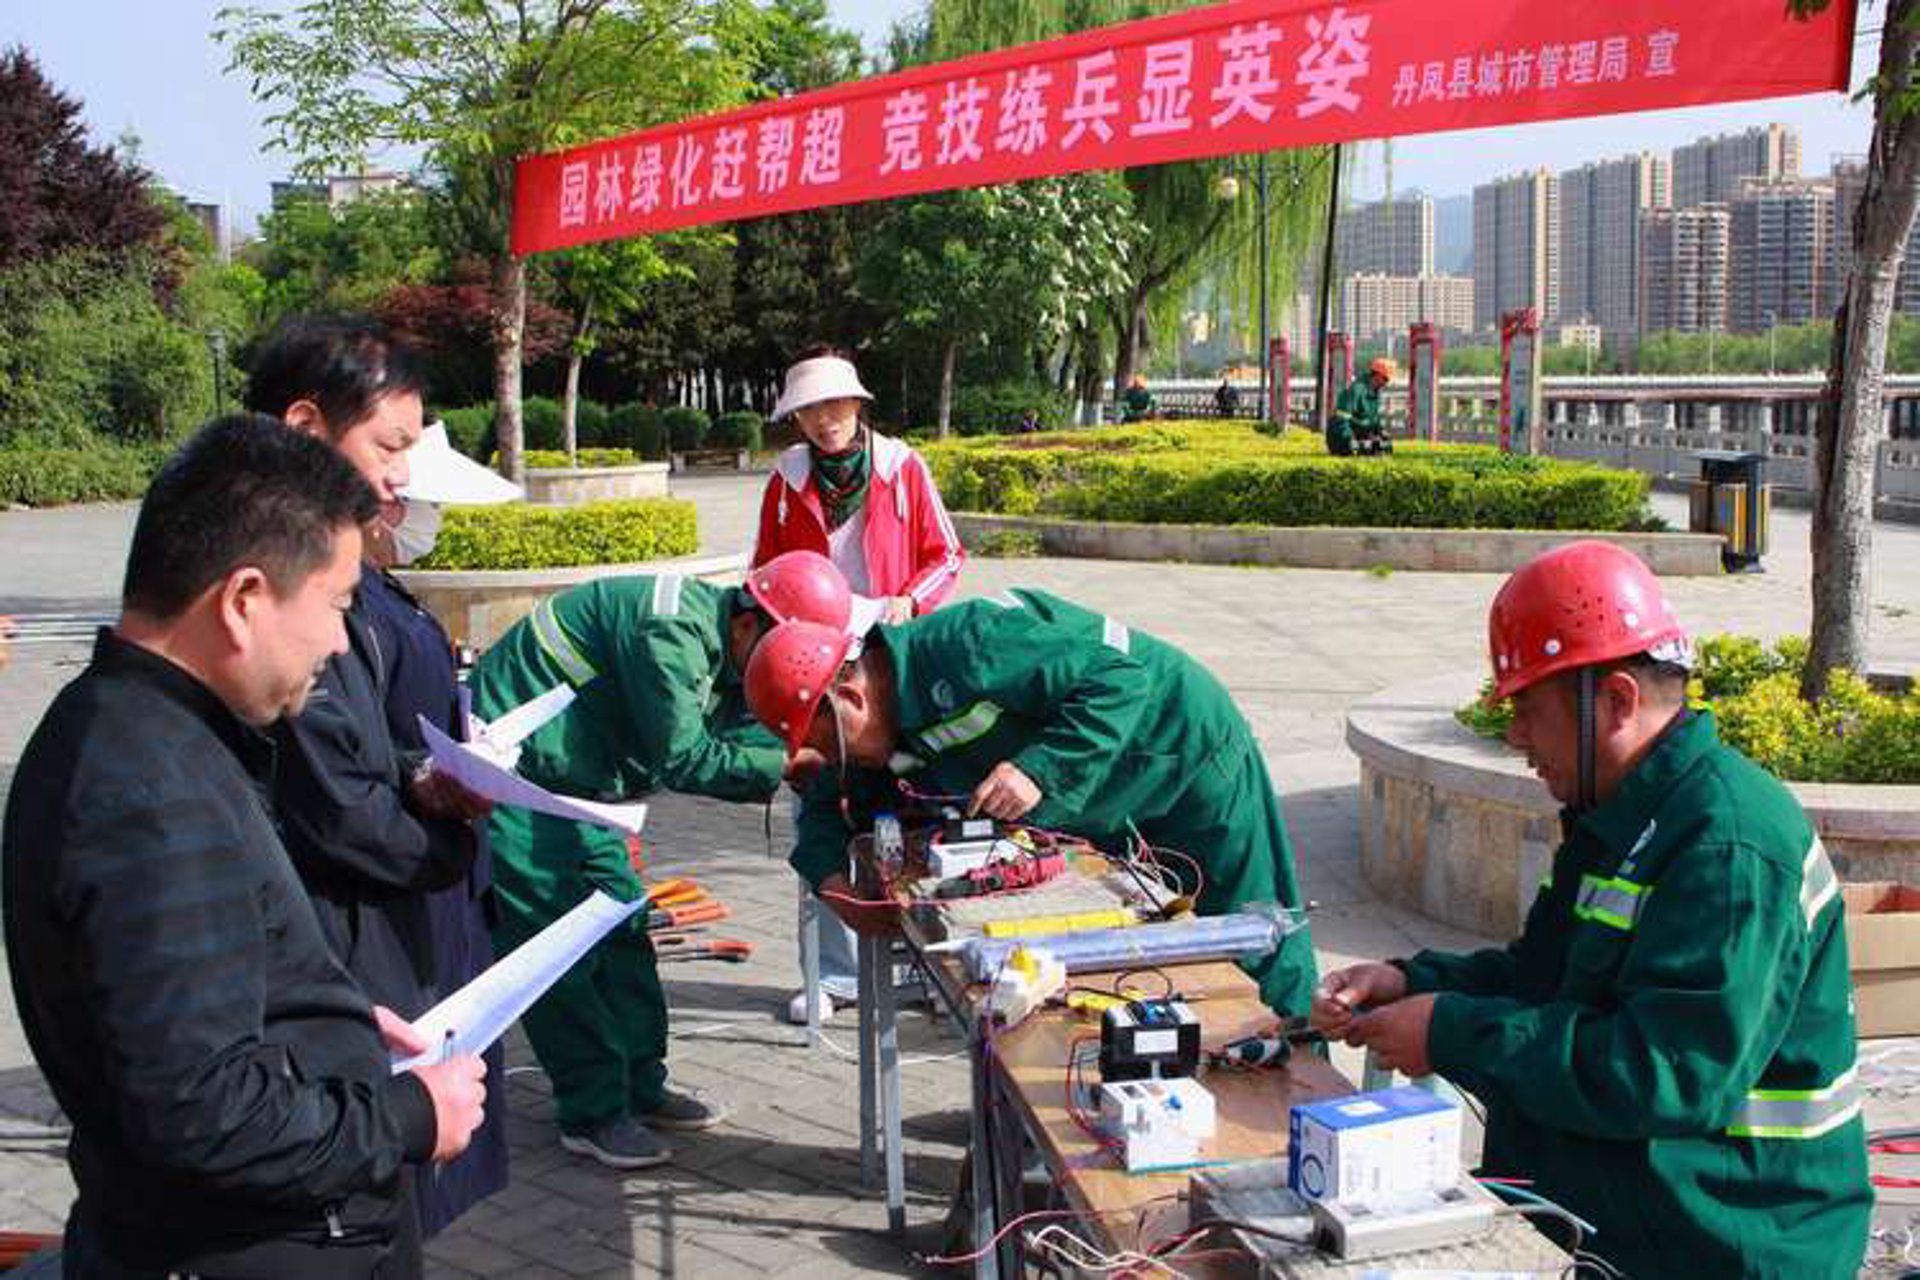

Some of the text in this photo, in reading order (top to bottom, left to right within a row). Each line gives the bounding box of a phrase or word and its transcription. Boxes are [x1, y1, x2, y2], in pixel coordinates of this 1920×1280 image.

[559, 8, 1371, 227] 园林绿化赶帮超 竞技练兵显英姿
[1392, 30, 1679, 106] 丹凤县城市管理局 宣
